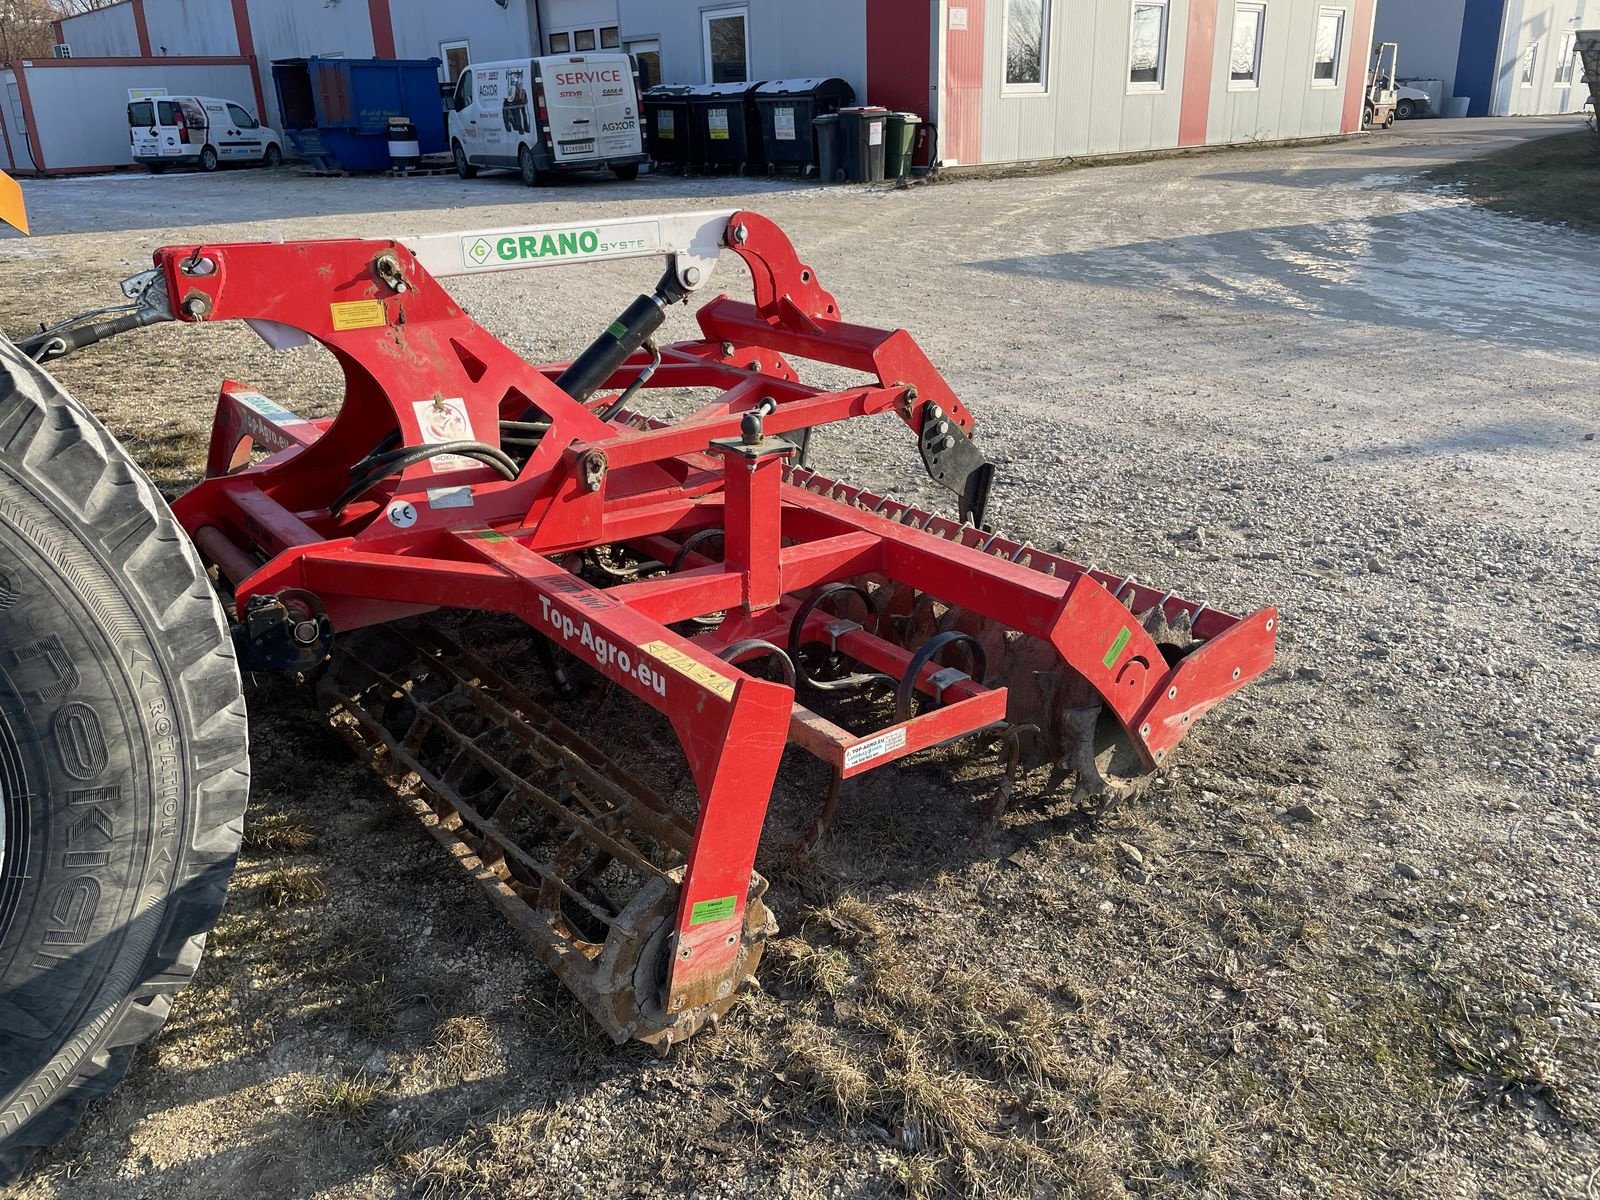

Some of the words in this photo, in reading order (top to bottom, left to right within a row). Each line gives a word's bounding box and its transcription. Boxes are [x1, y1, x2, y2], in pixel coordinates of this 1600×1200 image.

[555, 70, 622, 86] SERVICE
[559, 90, 583, 98] STEYR
[601, 120, 636, 132] AGXOR
[496, 230, 598, 261] GRANO
[538, 594, 667, 697] Top-Agro.eu
[148, 696, 180, 840] ROTATION
